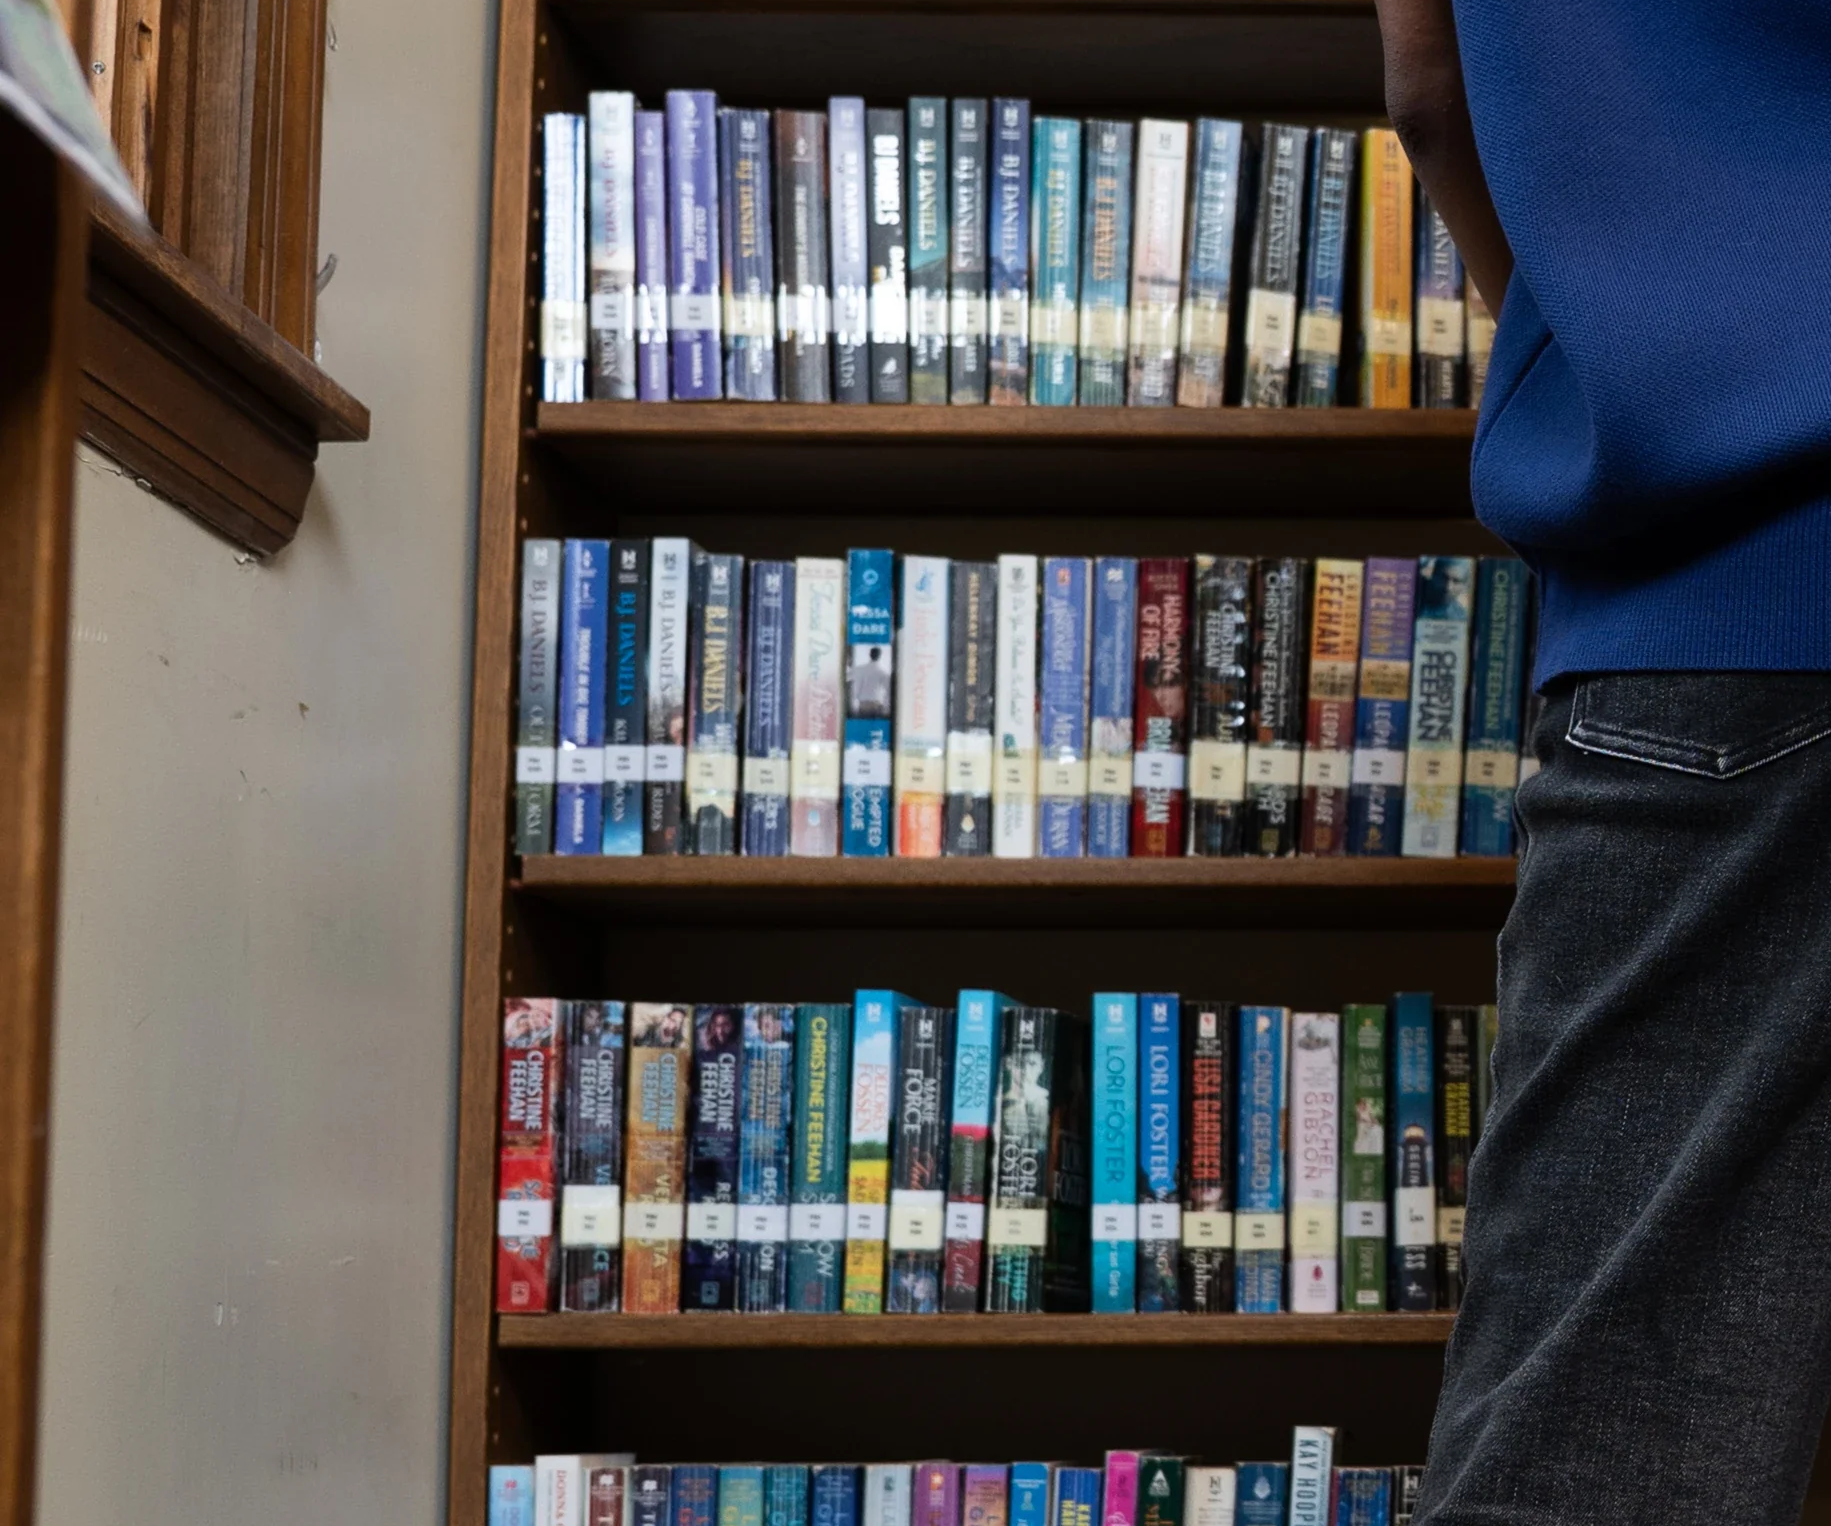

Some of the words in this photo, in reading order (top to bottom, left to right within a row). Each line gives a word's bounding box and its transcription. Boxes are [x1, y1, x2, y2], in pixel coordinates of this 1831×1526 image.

[917, 169, 936, 251] DANIELS
[957, 185, 975, 267] DANIELS
[1002, 185, 1020, 265] DANIELS
[1049, 196, 1065, 267] DANIELS
[1265, 202, 1286, 282] DANIELS
[1316, 211, 1341, 280] DANIELS
[1141, 629, 1160, 662] FIRE
[1142, 605, 1160, 626] OF
[1163, 594, 1181, 677] HARMONY
[1205, 610, 1221, 668] FEEHAN
[1263, 572, 1280, 657] CHRISTINE
[1316, 572, 1344, 656] FEEHAN
[1370, 569, 1397, 657] FEEHAN
[1488, 569, 1509, 659] CHRISTINE
[1260, 659, 1278, 728] FEEHAN
[1417, 650, 1439, 742] FEEHAN
[1438, 651, 1457, 742] CHRISTINE
[1485, 660, 1504, 730] FEEHAN
[509, 1059, 527, 1121] FEEHAN
[526, 1050, 545, 1130] CHRISTINE
[700, 1062, 717, 1123] FEEHAN
[718, 1053, 735, 1133] CHRISTINE
[808, 1017, 829, 1108] CHRISTINE
[903, 1067, 924, 1136] FORCE
[1106, 1044, 1125, 1094] LORI
[1149, 1044, 1170, 1096] LORI
[807, 1111, 827, 1183] FEEHAN
[1106, 1099, 1126, 1184] FOSTER
[1149, 1102, 1171, 1184] FOSTER
[1304, 1090, 1319, 1181] GIBSON
[1319, 1090, 1335, 1178] RACHEL
[1297, 1439, 1319, 1470] KAY
